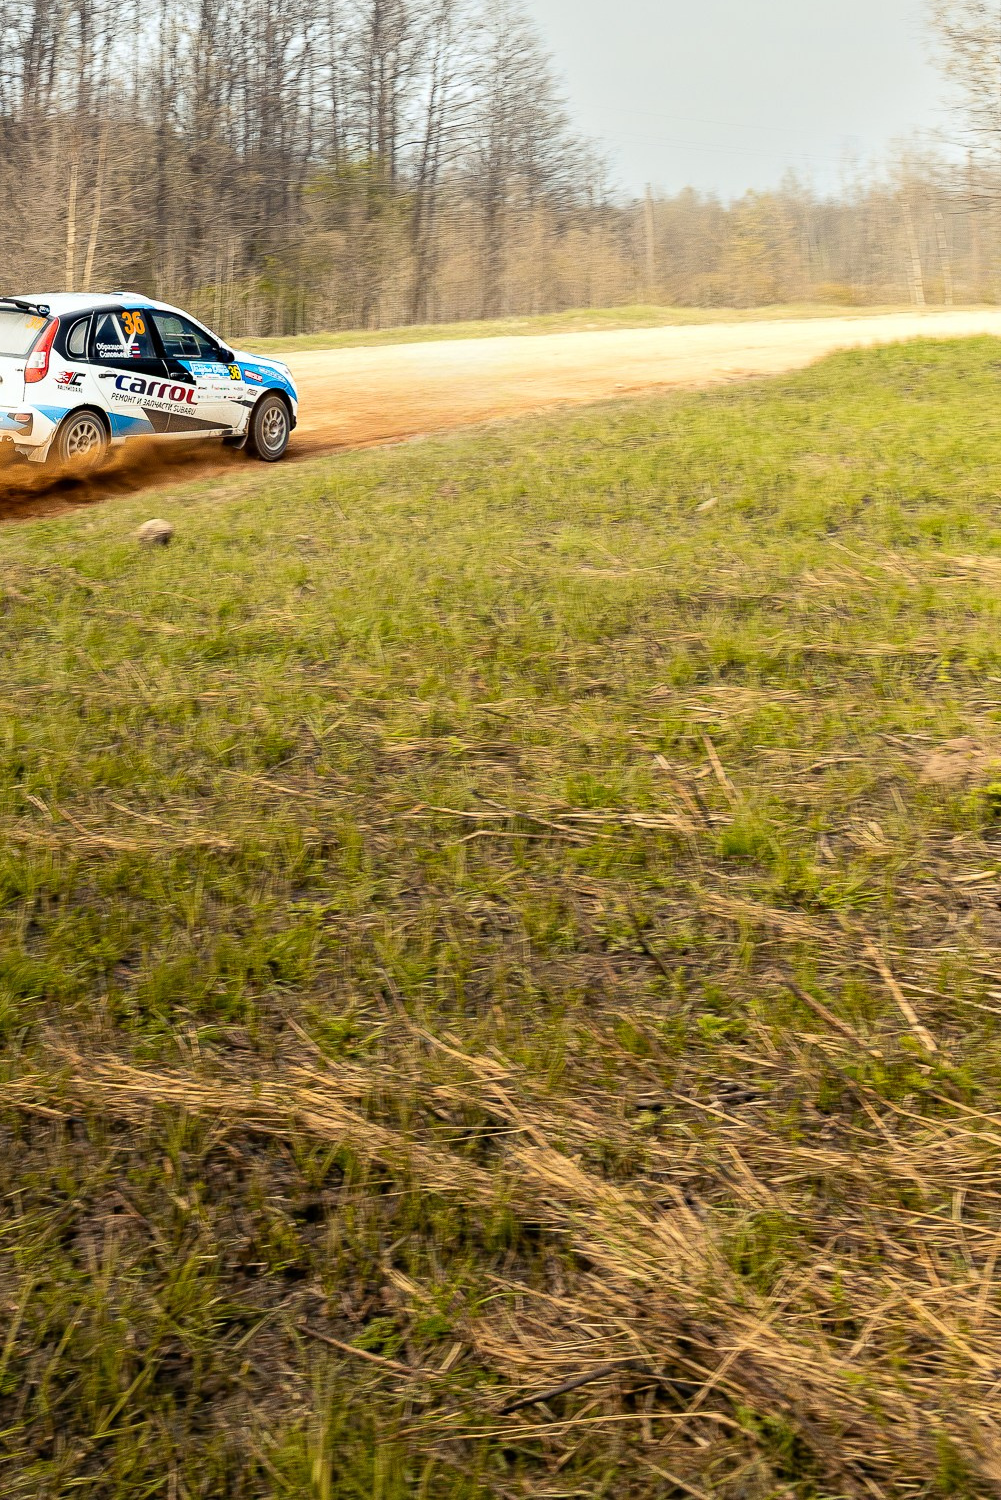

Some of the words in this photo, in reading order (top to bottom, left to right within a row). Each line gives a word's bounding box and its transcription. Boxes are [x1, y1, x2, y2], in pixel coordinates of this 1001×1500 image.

[25, 315, 46, 330] 36
[122, 311, 146, 335] 36
[228, 365, 241, 380] 36
[110, 392, 136, 404] РЕМОНТ
[136, 397, 142, 405] И
[142, 398, 173, 411] ЗАПЧАСТИ
[173, 404, 197, 416] SUBARU
